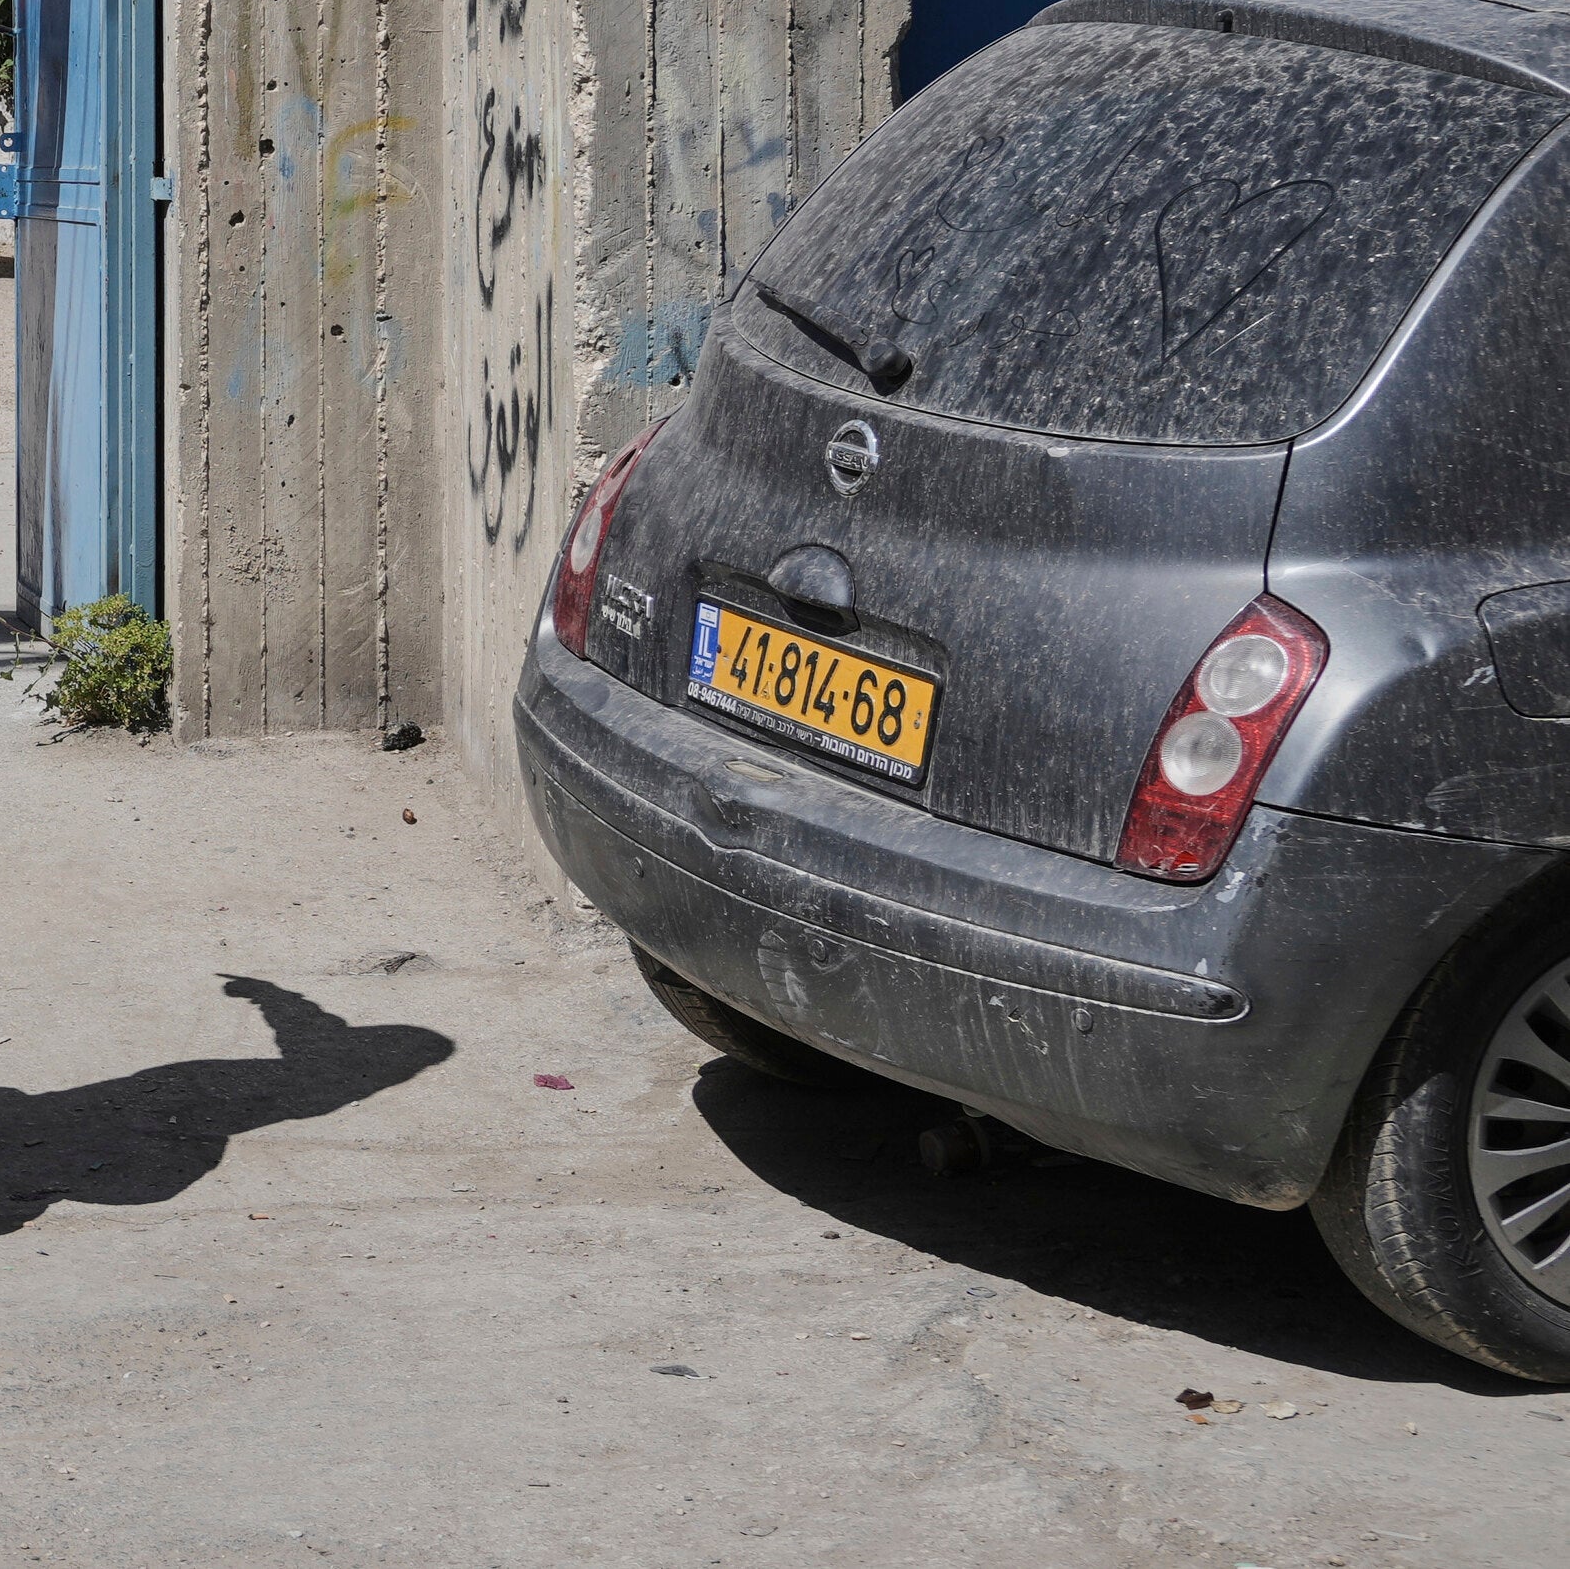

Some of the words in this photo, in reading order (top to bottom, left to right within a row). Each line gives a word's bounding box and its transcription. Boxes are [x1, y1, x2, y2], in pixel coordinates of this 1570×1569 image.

[467, 277, 553, 553] الوقوف
[698, 625, 712, 658] IL
[777, 720, 795, 735] לרכב
[856, 749, 888, 771] הדרום
[888, 761, 913, 779] מכון
